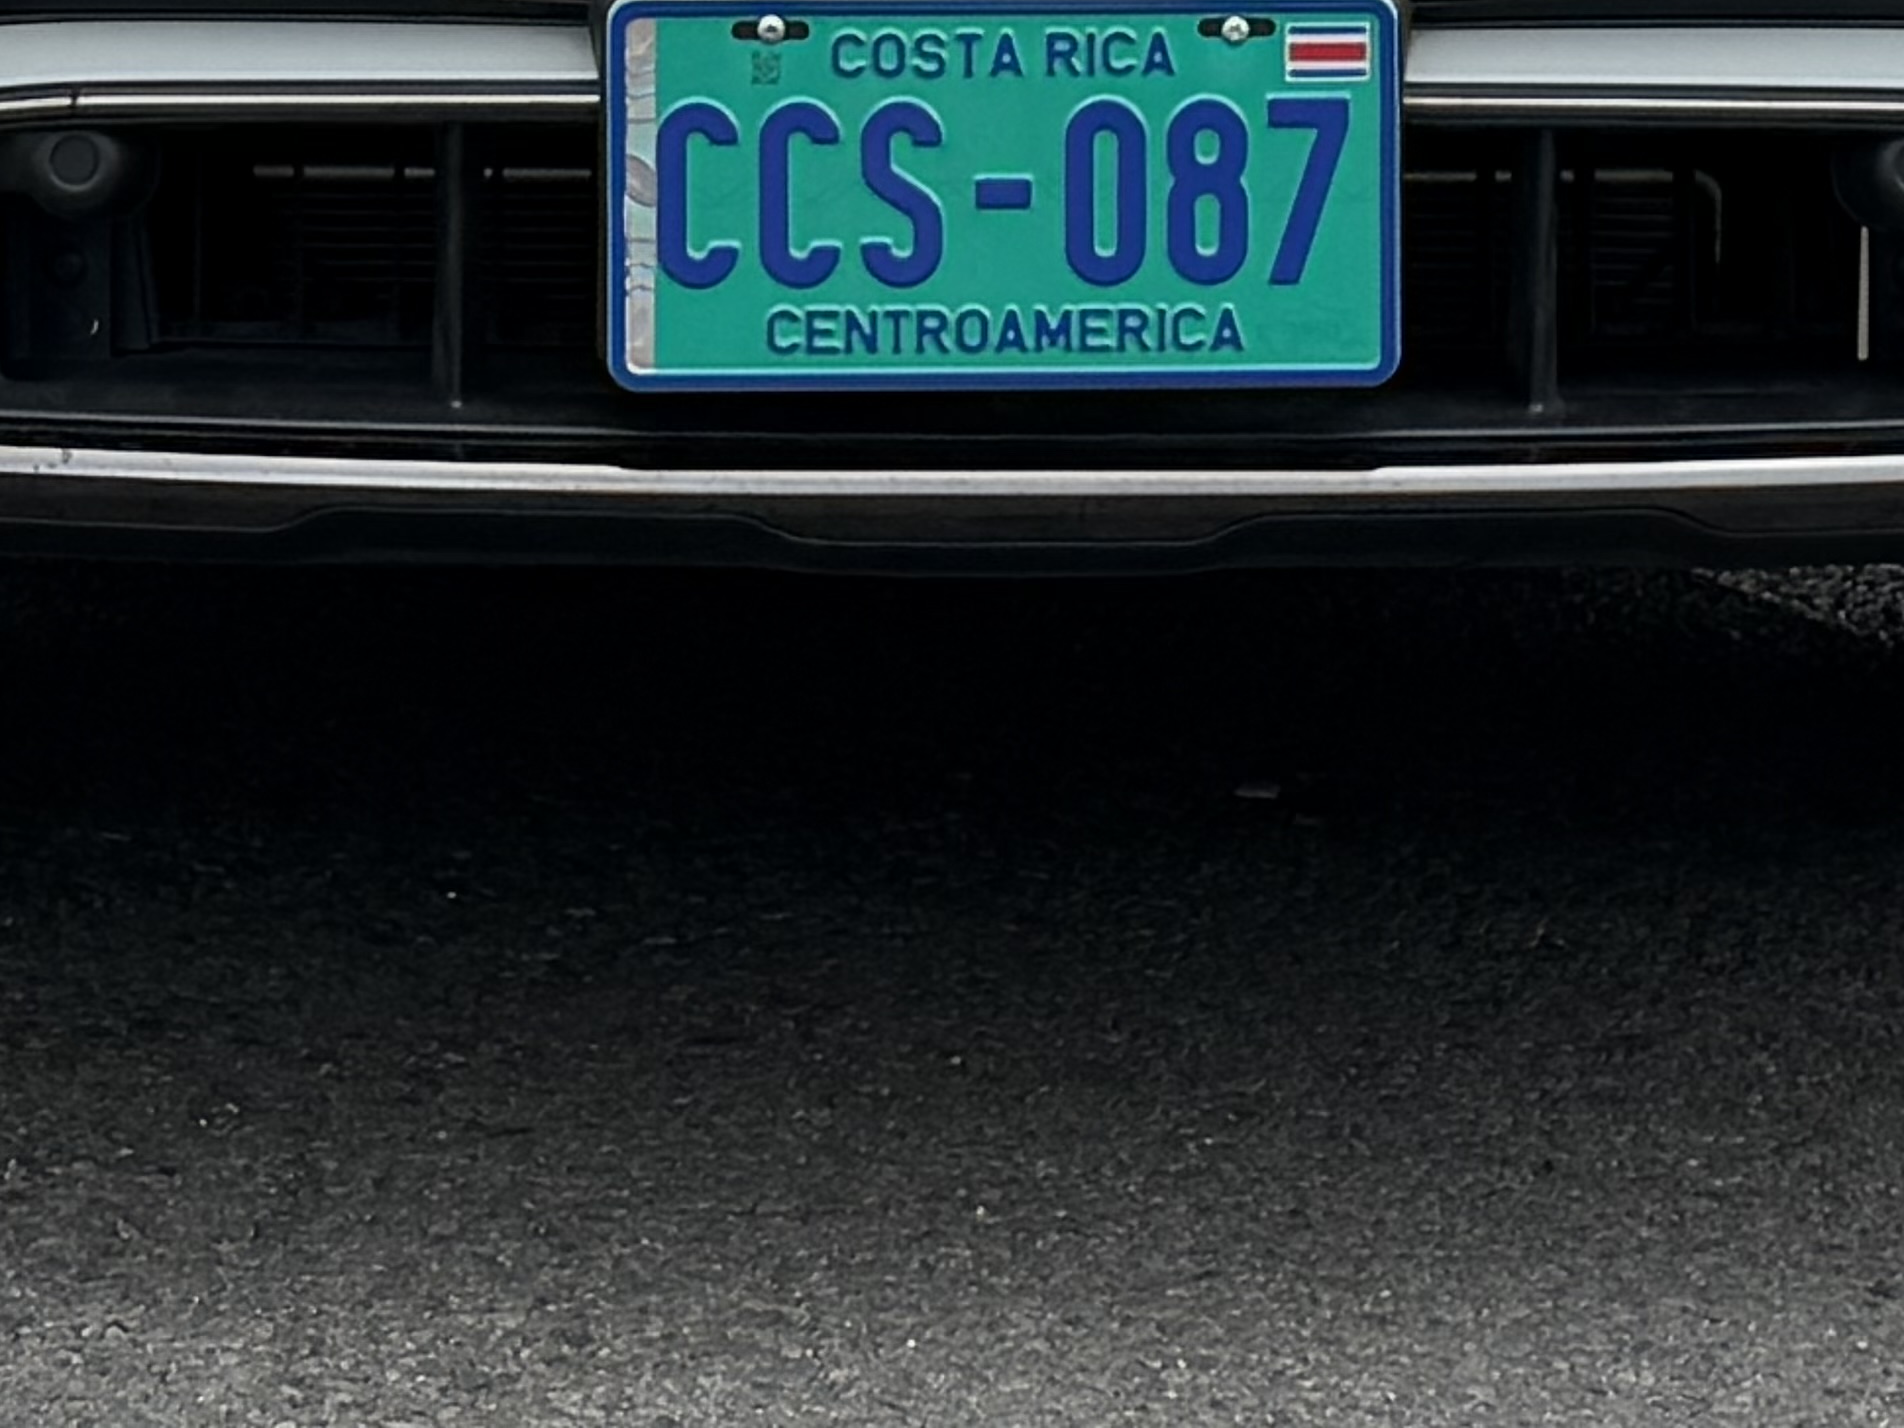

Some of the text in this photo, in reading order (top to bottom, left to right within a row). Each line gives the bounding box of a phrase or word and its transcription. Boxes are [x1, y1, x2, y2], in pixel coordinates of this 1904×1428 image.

[830, 28, 1176, 80] COSTA RICA
[655, 91, 1352, 291] CCS-087
[764, 303, 1245, 358] CENTROAMERICA
